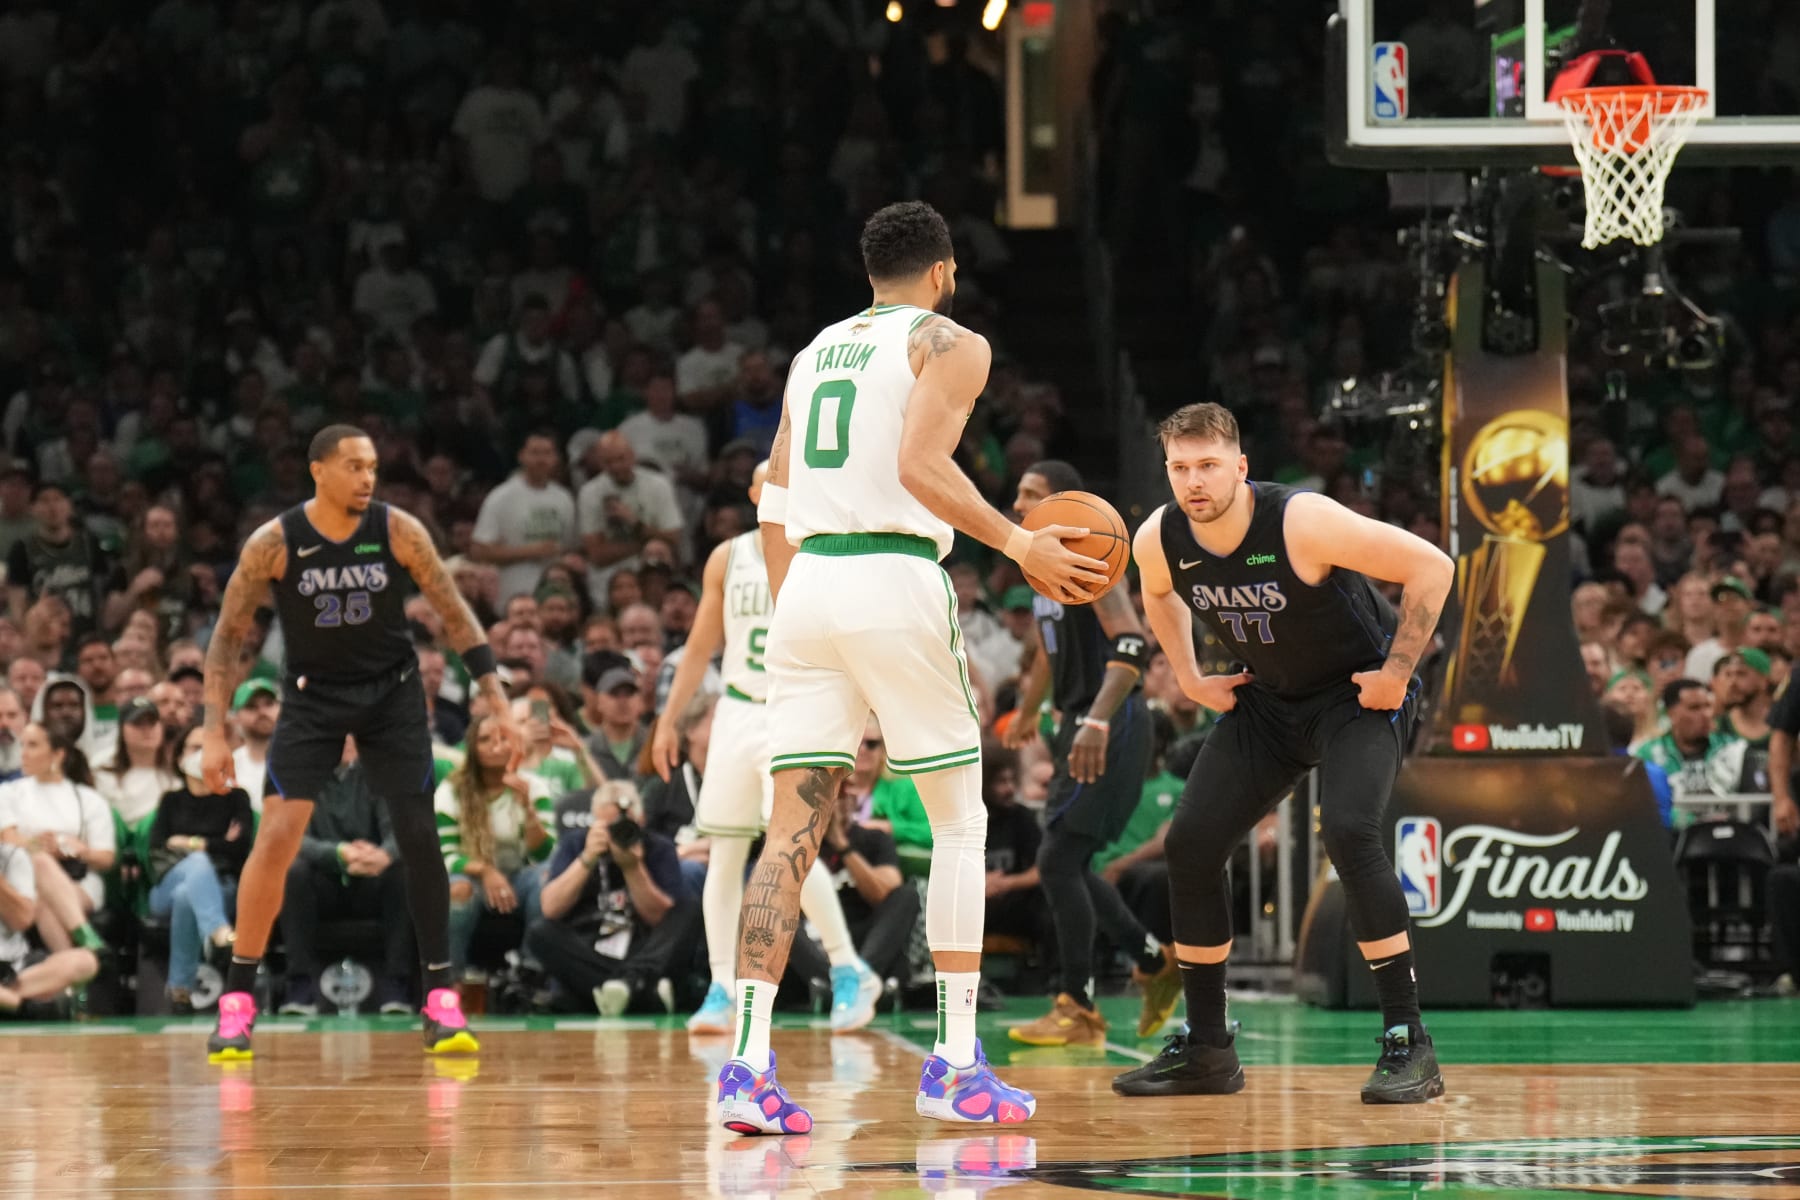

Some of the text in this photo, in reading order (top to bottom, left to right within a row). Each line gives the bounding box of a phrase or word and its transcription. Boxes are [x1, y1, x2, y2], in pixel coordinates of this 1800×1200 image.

[816, 342, 877, 373] TATUM
[804, 379, 857, 469] 0
[1246, 554, 1277, 566] chime
[297, 563, 389, 597] MAVS
[314, 592, 372, 628] 25
[1192, 582, 1288, 612] MAVS
[1217, 611, 1275, 644] 77
[1415, 824, 1648, 928] Finals
